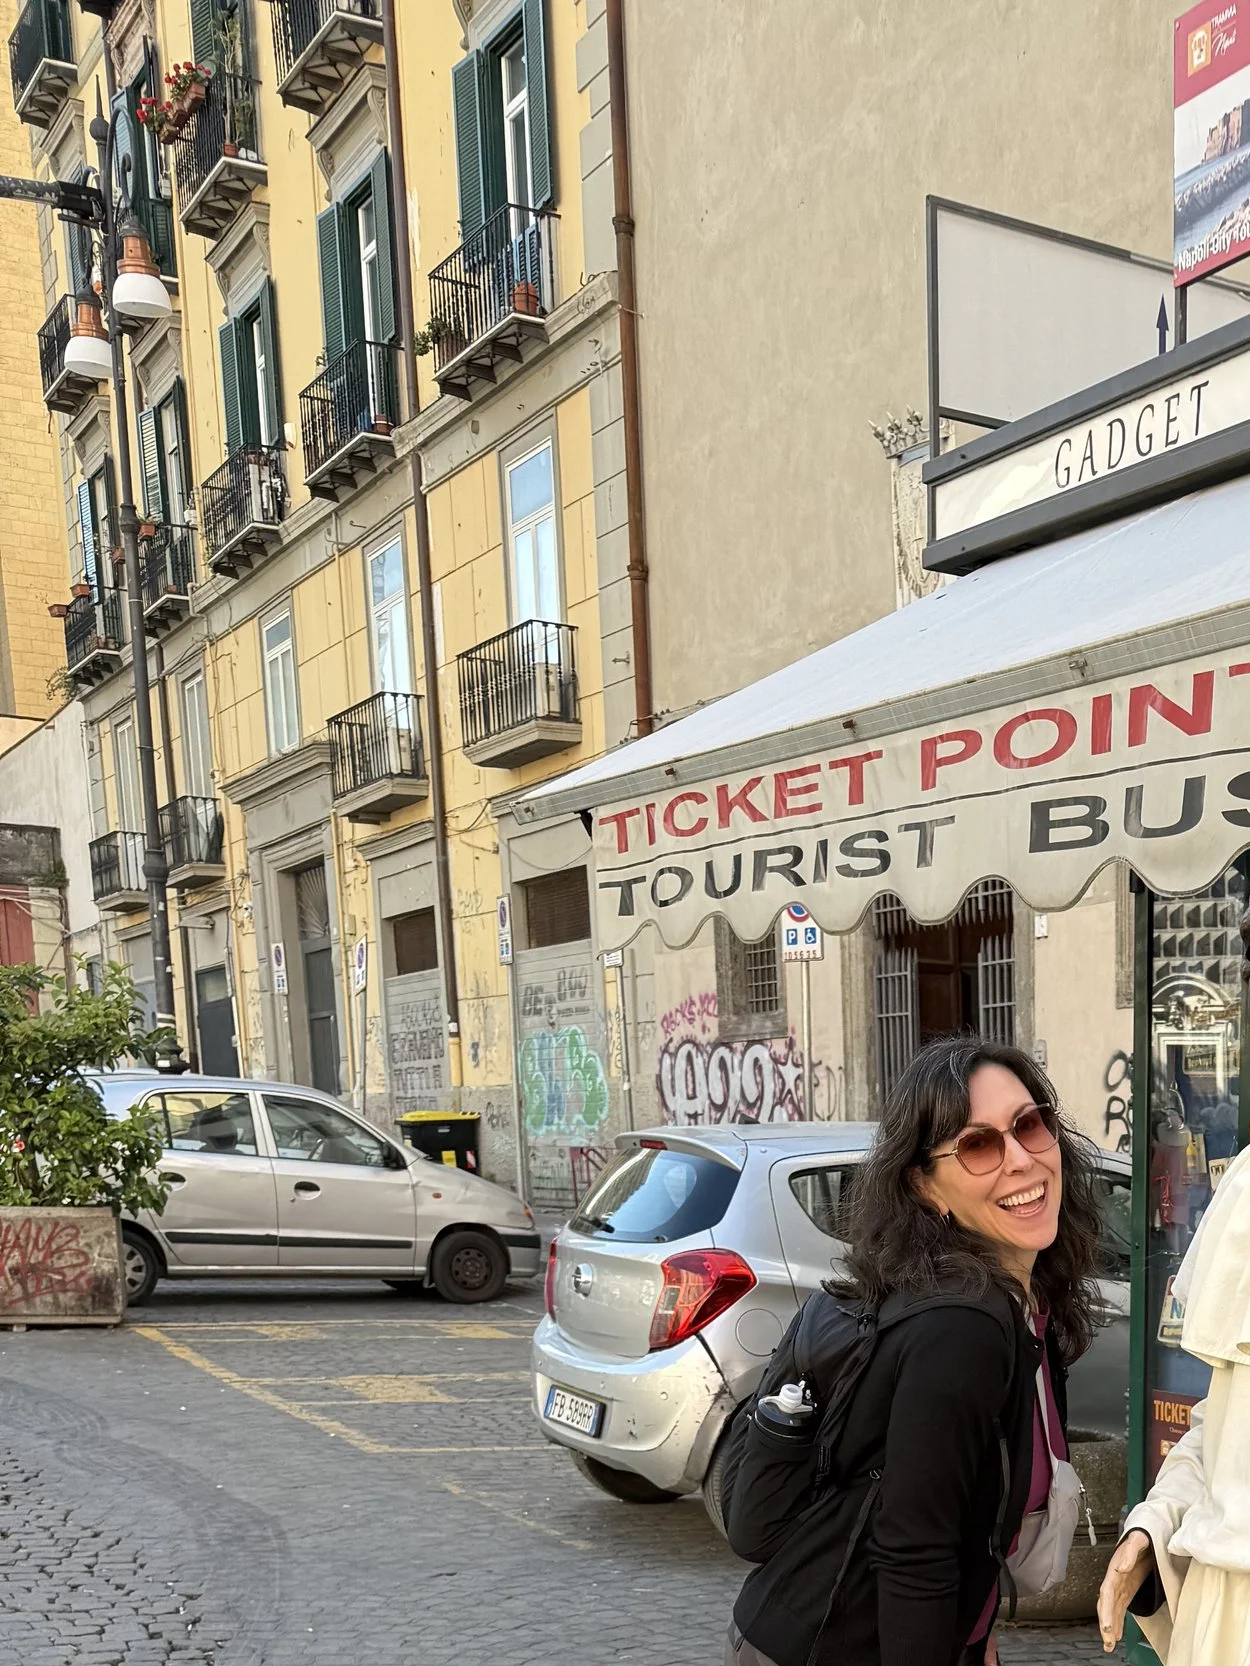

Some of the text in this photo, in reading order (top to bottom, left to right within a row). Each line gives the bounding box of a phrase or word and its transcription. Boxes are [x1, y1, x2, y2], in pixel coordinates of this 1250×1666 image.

[1055, 380, 1210, 490] GADGET
[599, 750, 883, 854] TICKET
[599, 815, 956, 918] TOURIST
